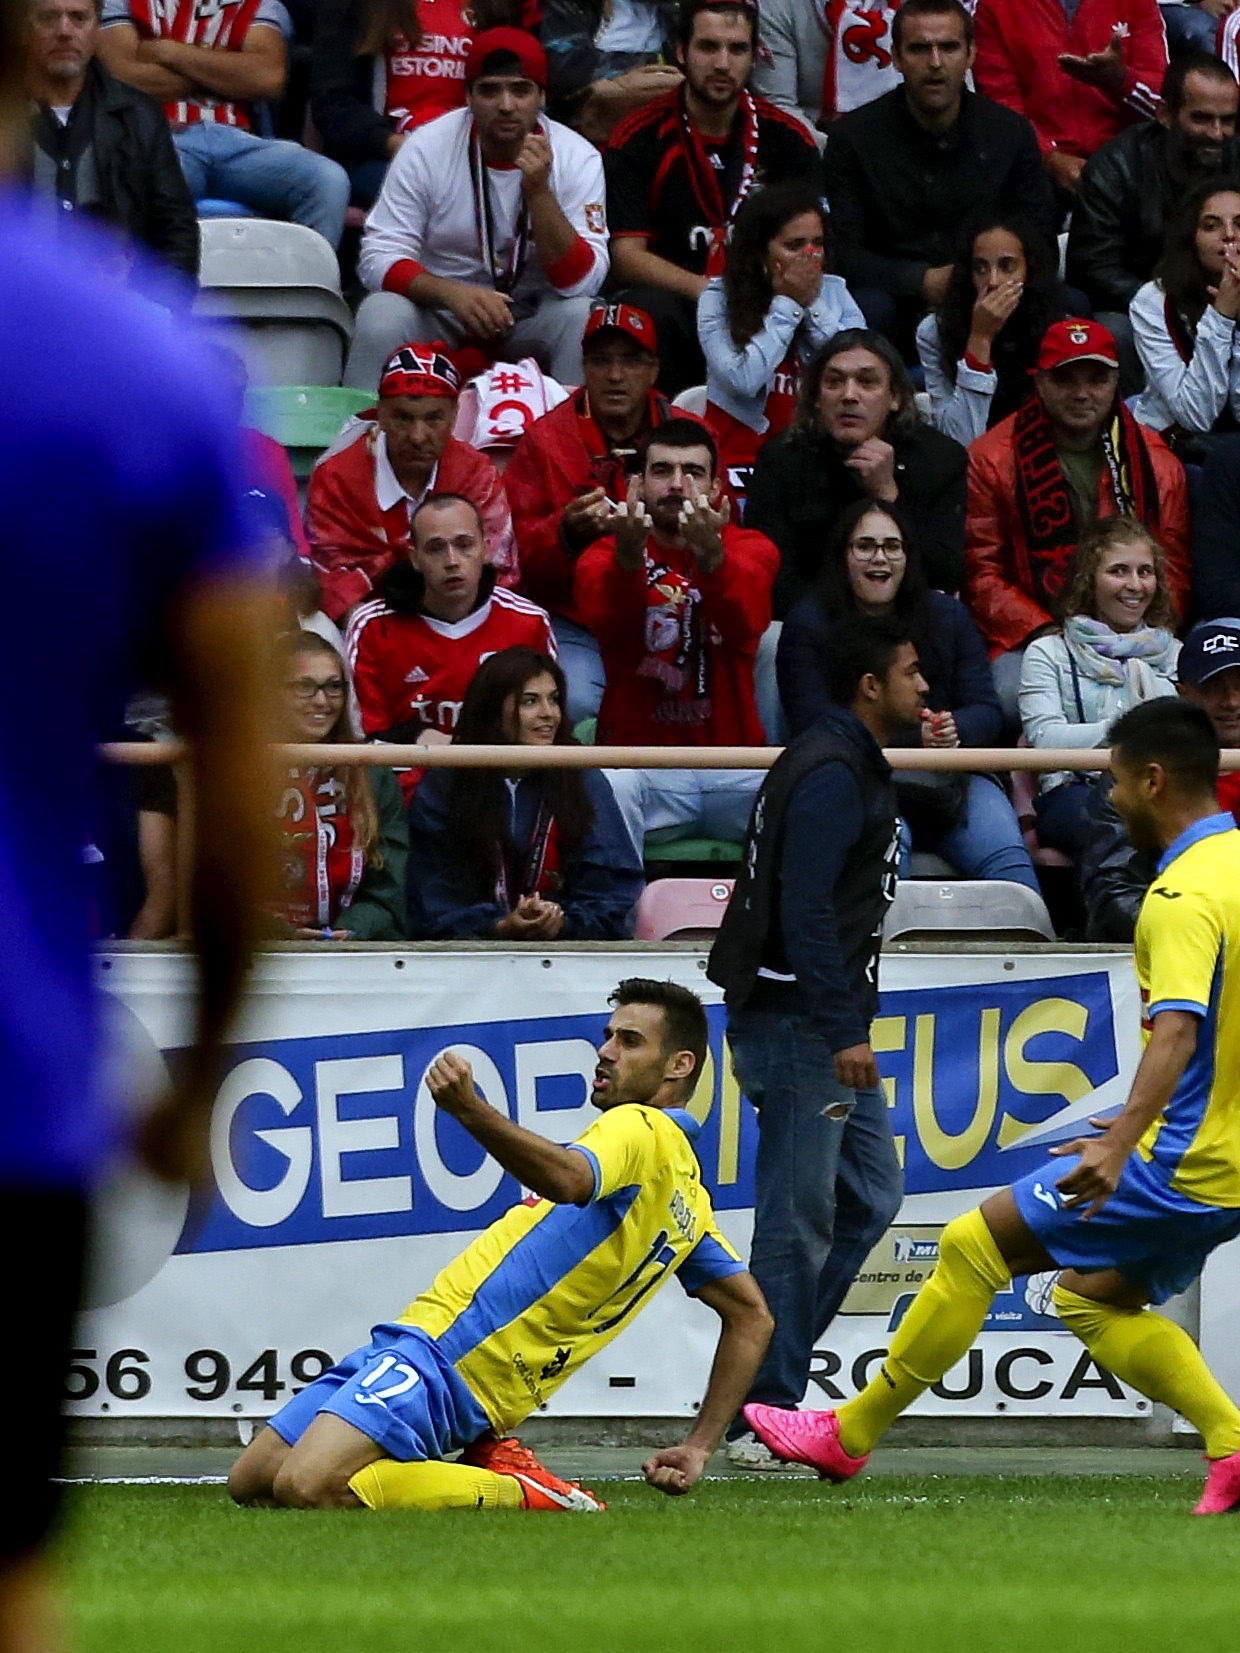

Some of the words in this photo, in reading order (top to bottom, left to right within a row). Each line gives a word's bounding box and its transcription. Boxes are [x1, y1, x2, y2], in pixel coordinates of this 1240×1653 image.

[853, 1271, 899, 1283] entro
[904, 1270, 922, 1283] de
[60, 1349, 150, 1401] 56
[185, 1349, 336, 1401] 949
[360, 1356, 421, 1398] 17
